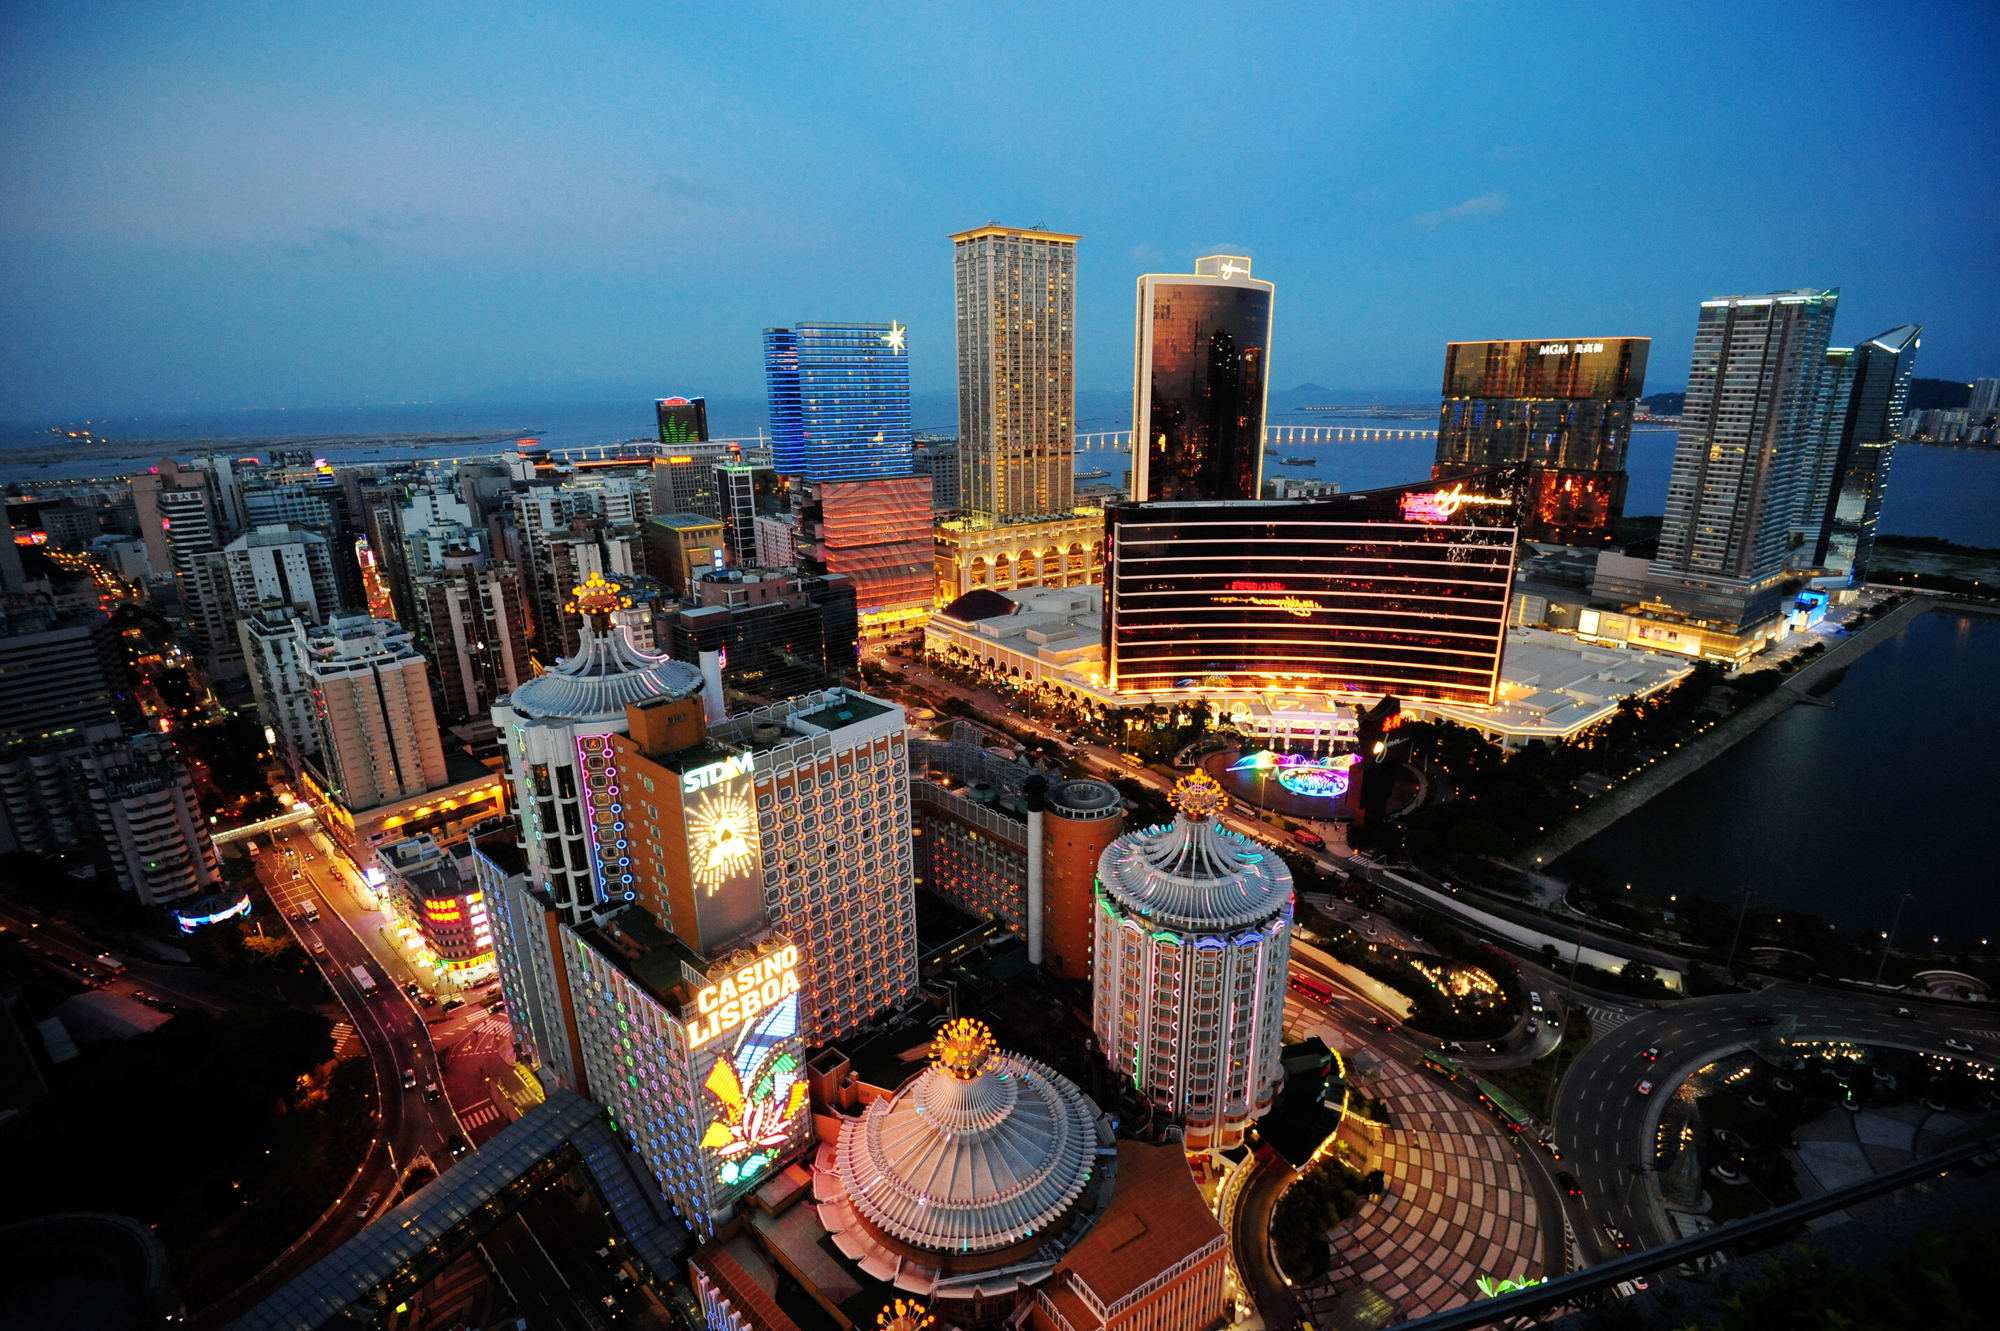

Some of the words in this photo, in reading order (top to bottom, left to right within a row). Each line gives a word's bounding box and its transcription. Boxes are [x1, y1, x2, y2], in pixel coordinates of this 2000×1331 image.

[1539, 344, 1568, 355] MGM
[683, 751, 755, 793] STDM
[698, 944, 798, 1015] CASINO
[687, 970, 801, 1050] LISBOA
